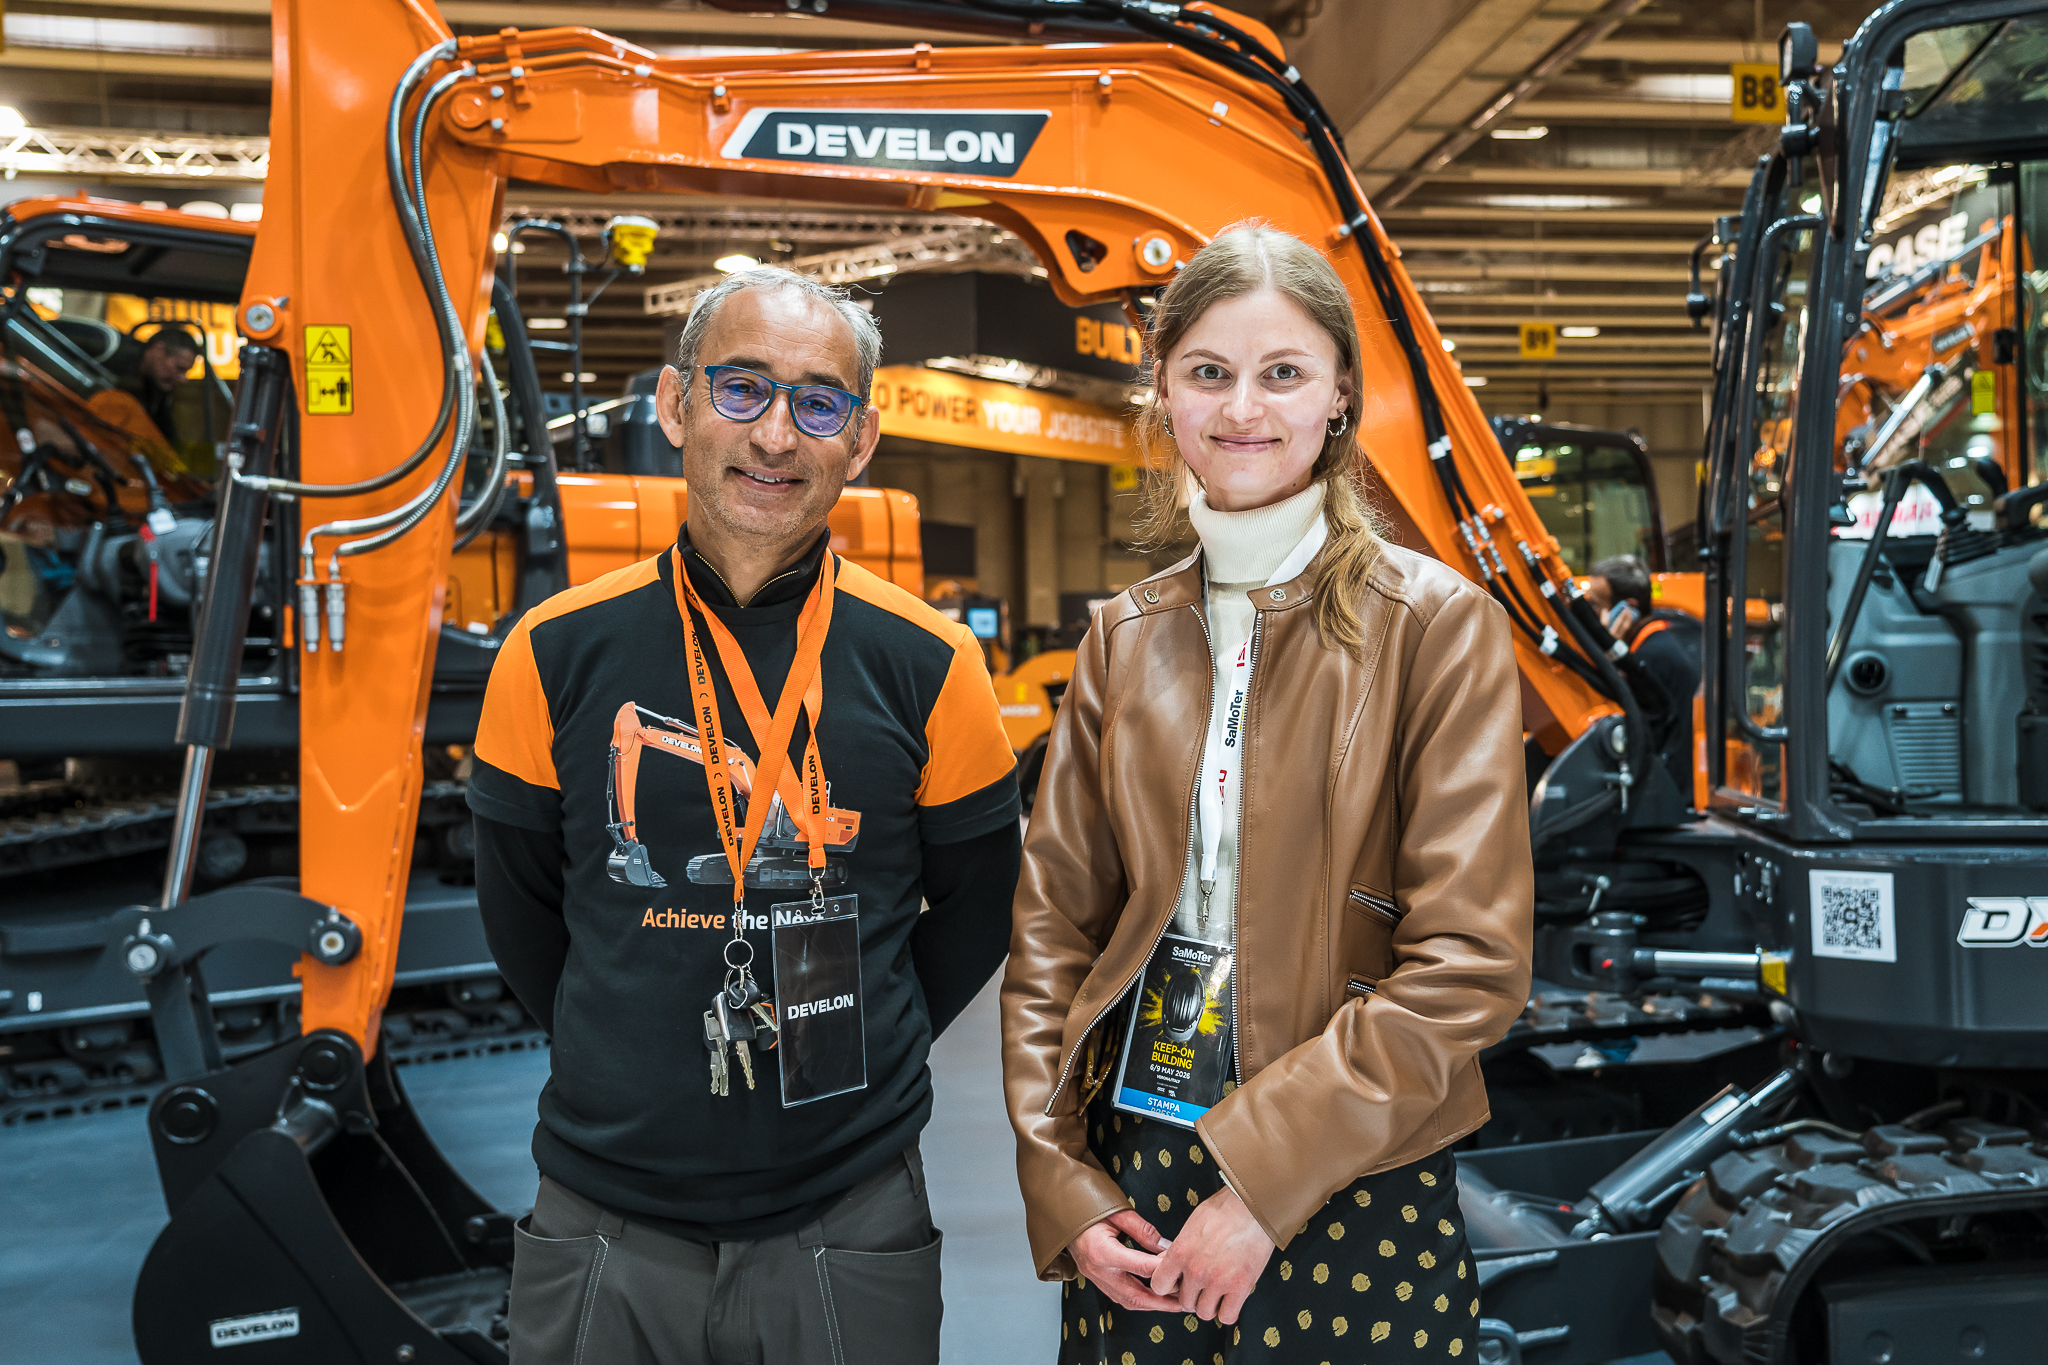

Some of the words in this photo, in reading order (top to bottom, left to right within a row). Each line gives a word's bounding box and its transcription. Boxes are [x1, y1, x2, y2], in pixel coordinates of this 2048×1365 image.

[1741, 74, 1777, 110] B8
[776, 122, 1015, 164] DEVELON
[1865, 210, 1969, 279] CASE
[900, 386, 979, 426] POWER
[981, 399, 1042, 437] YOUR
[1225, 689, 1244, 748] SaMoTer
[661, 735, 702, 754] DEVELON
[702, 706, 720, 764] DEVELON
[808, 754, 820, 815] DEVELON
[717, 786, 734, 847] DEVELON
[641, 907, 726, 929] Achieve
[732, 909, 769, 930] the
[1172, 946, 1213, 962] SaMoTer
[787, 993, 854, 1020] DEVELON
[1151, 1051, 1193, 1070] BUILDING
[1153, 1040, 1196, 1059] KEEP-ON
[1149, 1063, 1161, 1072] 6/9
[1161, 1066, 1175, 1076] MAY
[1147, 1097, 1181, 1113] STAMPA
[215, 1318, 296, 1339] DEVELON
